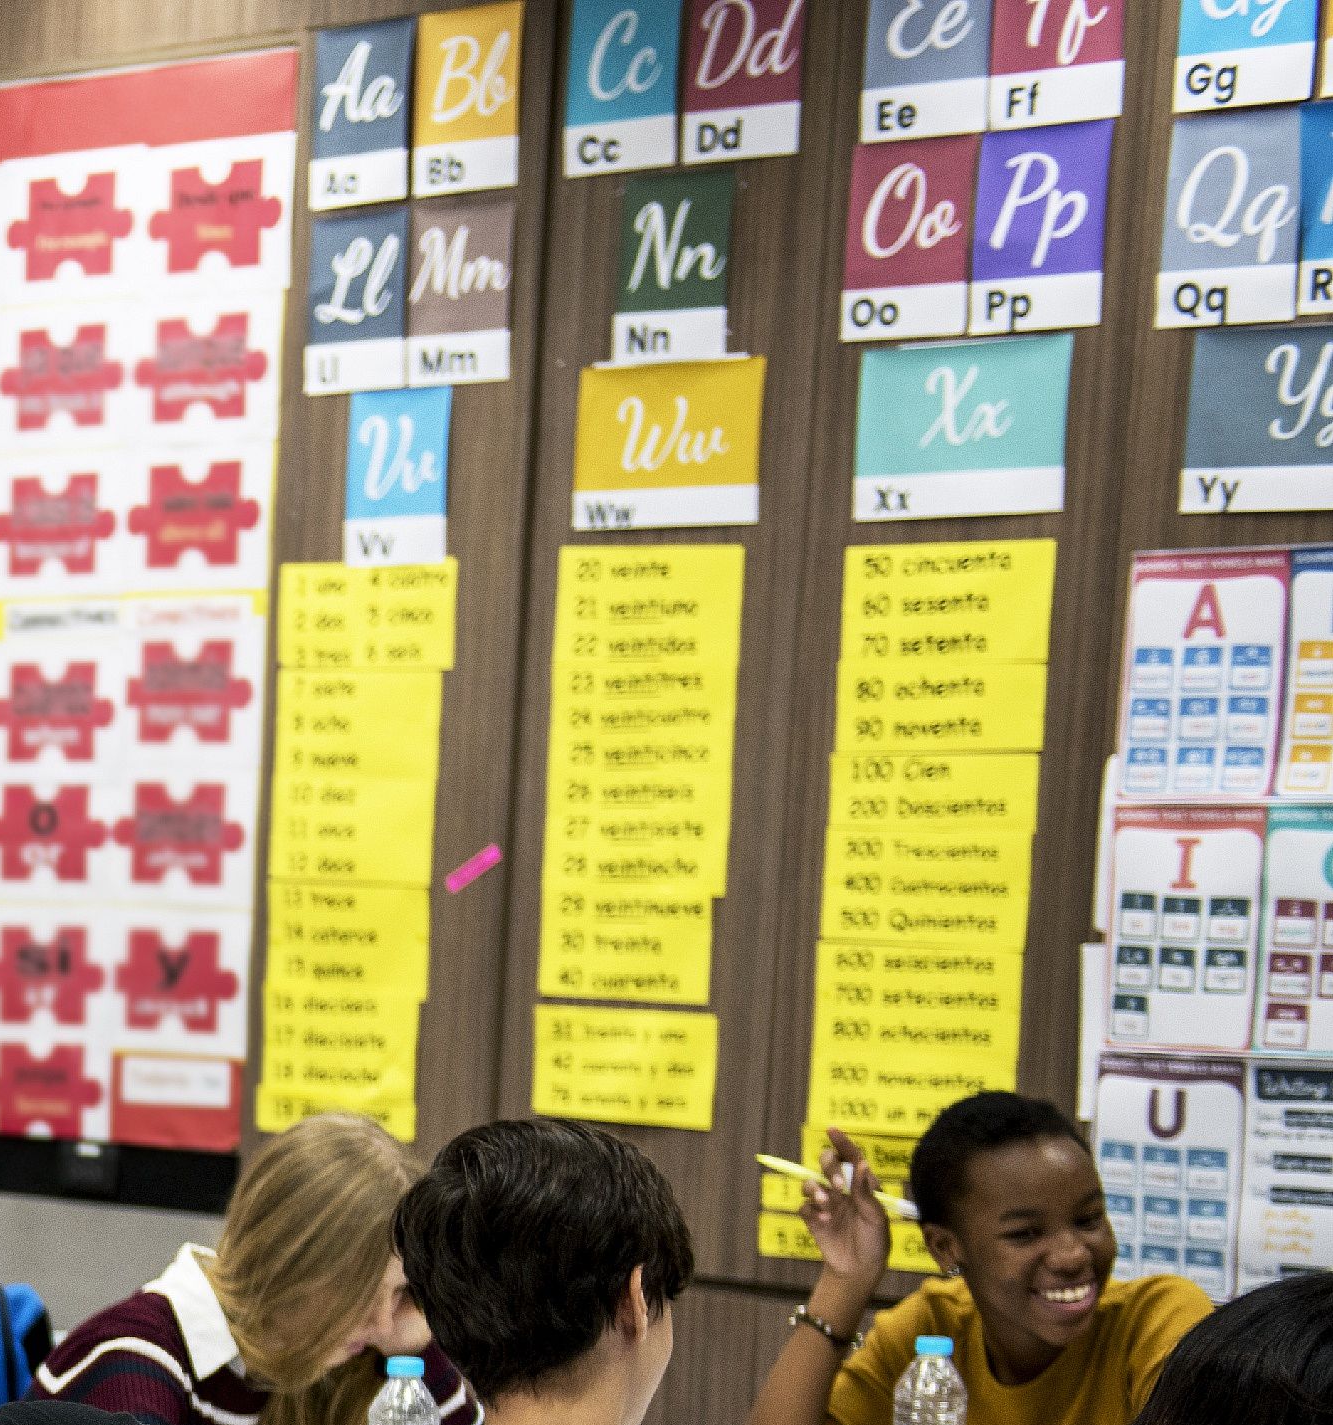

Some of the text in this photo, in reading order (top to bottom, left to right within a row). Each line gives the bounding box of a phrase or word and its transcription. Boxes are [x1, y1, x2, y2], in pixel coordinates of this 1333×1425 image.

[588, 10, 663, 101] Cc
[696, 0, 803, 89] Dd
[320, 41, 404, 132] Aa
[432, 31, 515, 123] Bb
[1186, 63, 1238, 102] Gg
[877, 100, 916, 131] Ee
[1005, 82, 1043, 118] Ff
[578, 135, 621, 165] Cc
[697, 119, 742, 152] Dd
[426, 157, 464, 185] Bb
[862, 163, 962, 259] Oo
[990, 152, 1089, 268] Pp
[1177, 146, 1297, 263] Qq
[628, 199, 726, 291] Nn
[410, 226, 509, 304] Mm
[852, 299, 899, 328] Oo
[986, 289, 1032, 333] Pp
[1174, 282, 1229, 327] Qq
[627, 325, 670, 354] Nn
[420, 348, 478, 375] Mm
[919, 365, 1013, 449] Xx
[874, 487, 911, 512] Xx
[1197, 476, 1239, 512] Yy
[863, 551, 1012, 579] 50 cincuenta
[862, 593, 989, 618] 60 sesenta
[1183, 584, 1225, 639] A
[899, 634, 987, 654] setenta
[856, 677, 985, 702] 80 ochenta
[893, 717, 982, 738] noventa
[851, 759, 950, 783] 100 Cien
[1148, 1088, 1187, 1138] U
